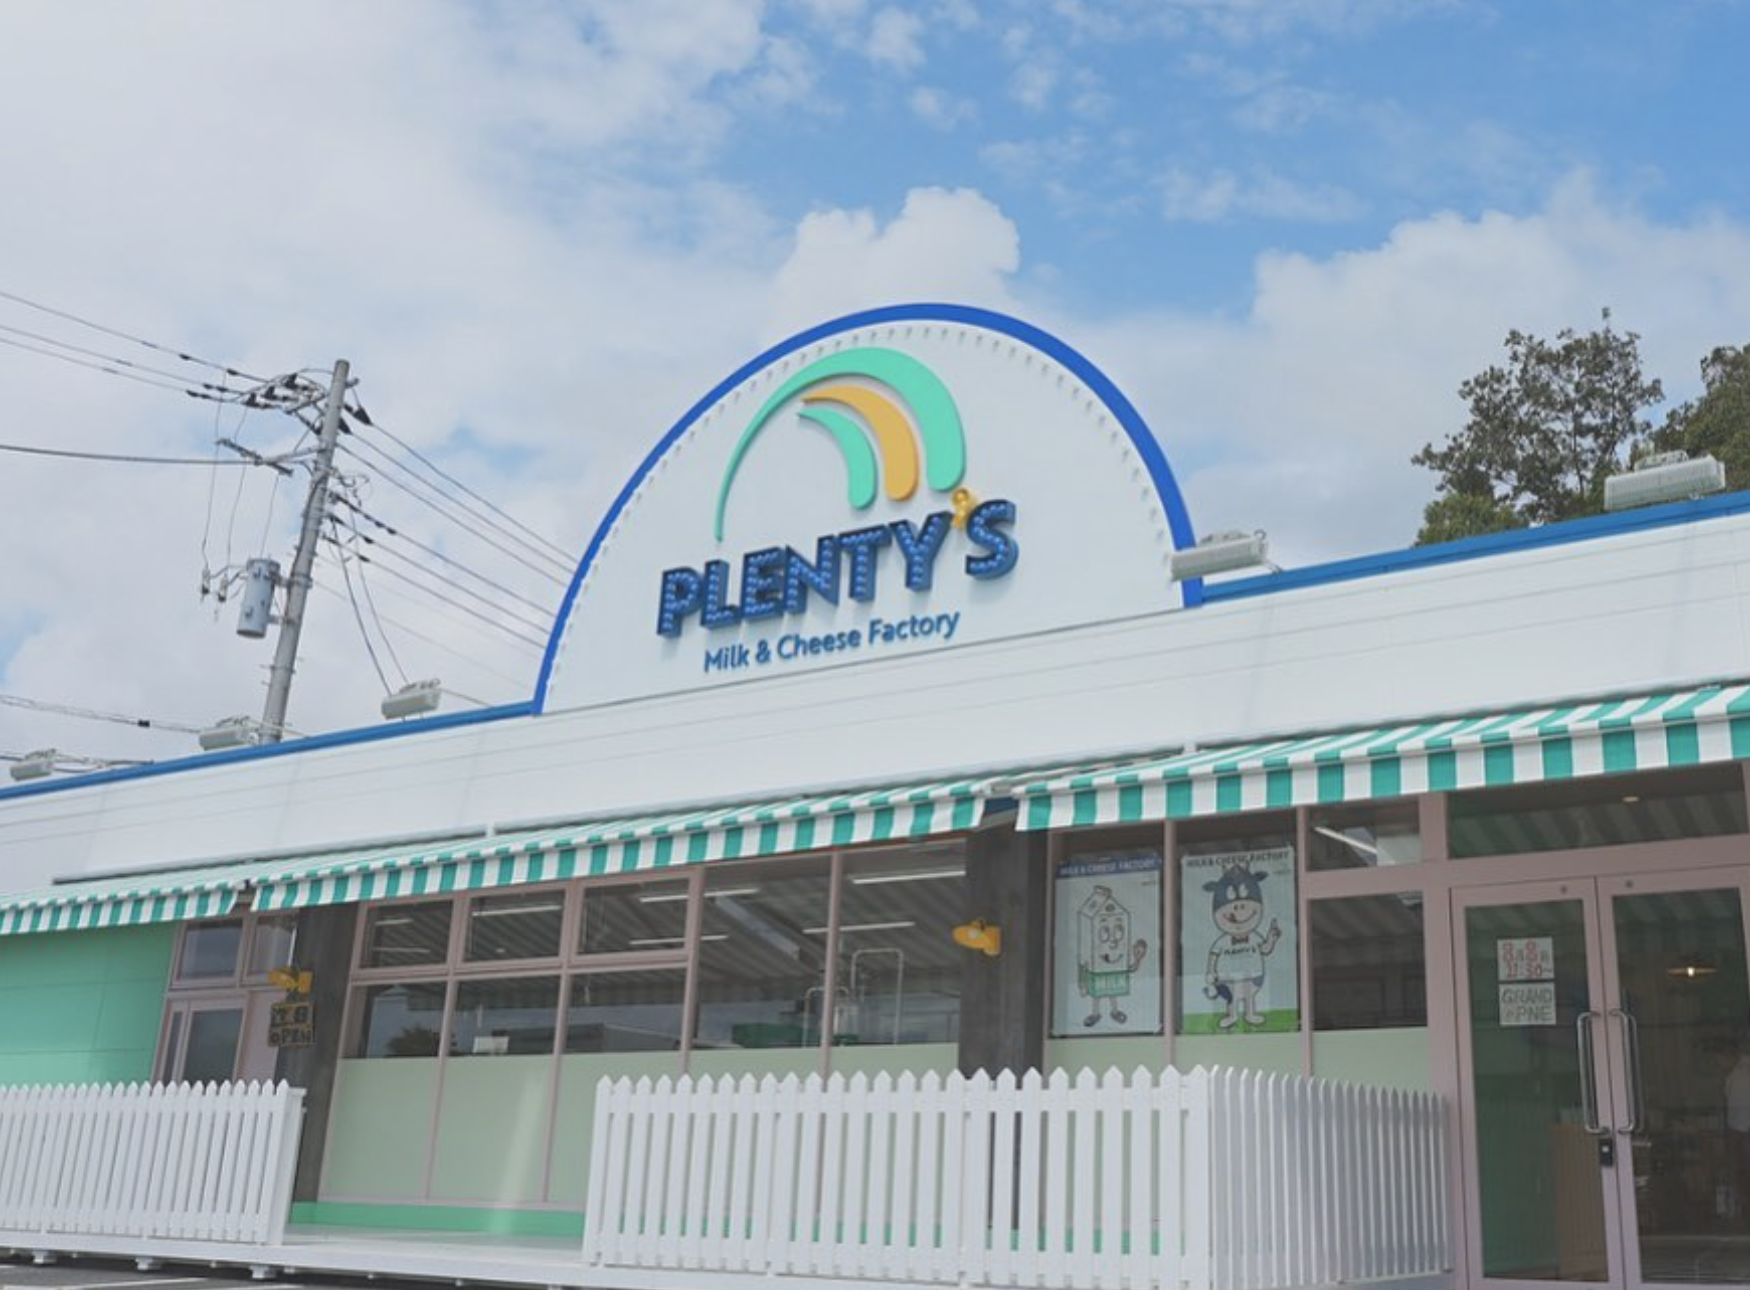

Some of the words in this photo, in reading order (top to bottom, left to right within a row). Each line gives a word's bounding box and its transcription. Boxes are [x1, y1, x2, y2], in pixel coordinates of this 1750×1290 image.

[657, 490, 1019, 638] PLENTY'S
[704, 643, 750, 673] Milk
[755, 639, 771, 663] &
[777, 629, 862, 660] Cheese
[868, 612, 960, 645] Factory
[1502, 987, 1553, 1004] GRAND
